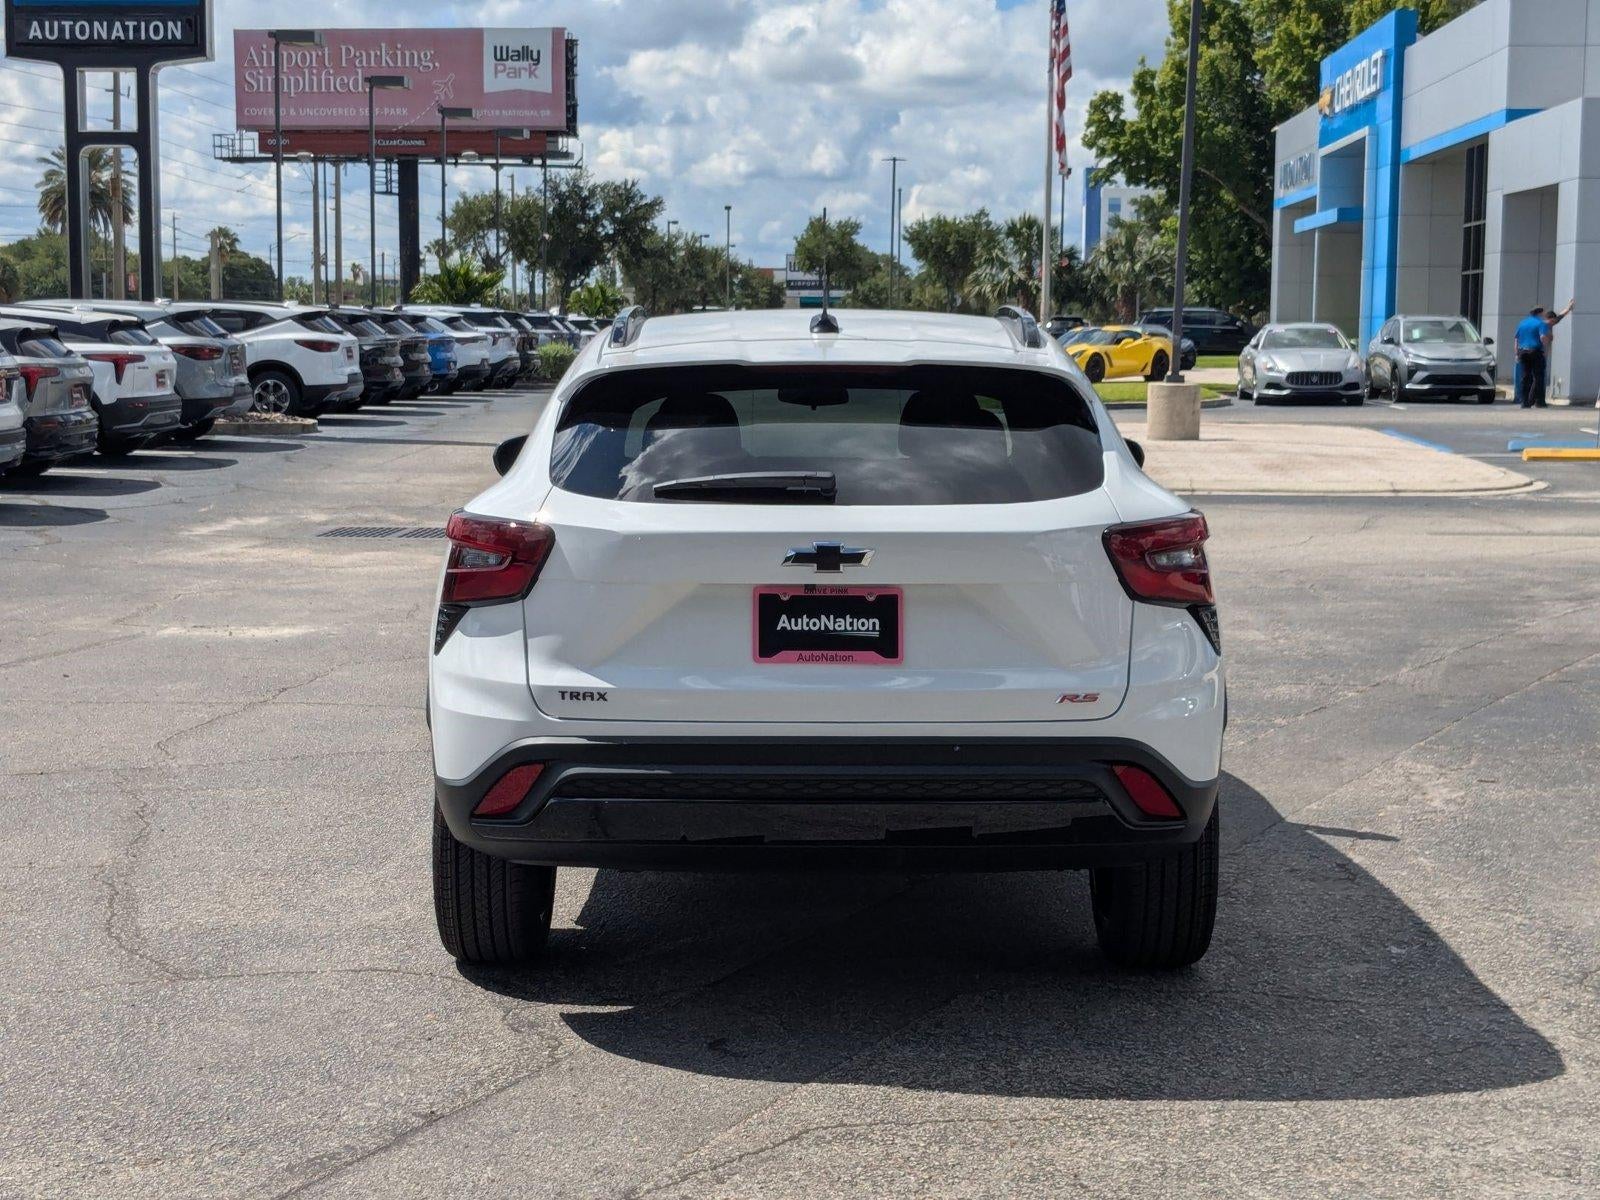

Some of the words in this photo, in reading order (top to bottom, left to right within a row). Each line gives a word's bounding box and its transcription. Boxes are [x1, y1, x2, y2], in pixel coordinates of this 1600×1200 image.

[28, 20, 183, 41] AUTONATION
[341, 43, 440, 72] Parking,
[493, 45, 541, 66] Wally
[494, 62, 539, 79] Park
[1334, 49, 1383, 114] CHEVROLET
[244, 107, 287, 116] COVERD
[301, 107, 356, 116] UNCOVERED
[359, 107, 408, 116] SEF-PARK
[776, 614, 880, 631] AutoNation
[558, 690, 608, 702] TRAX
[1055, 693, 1100, 704] RS
